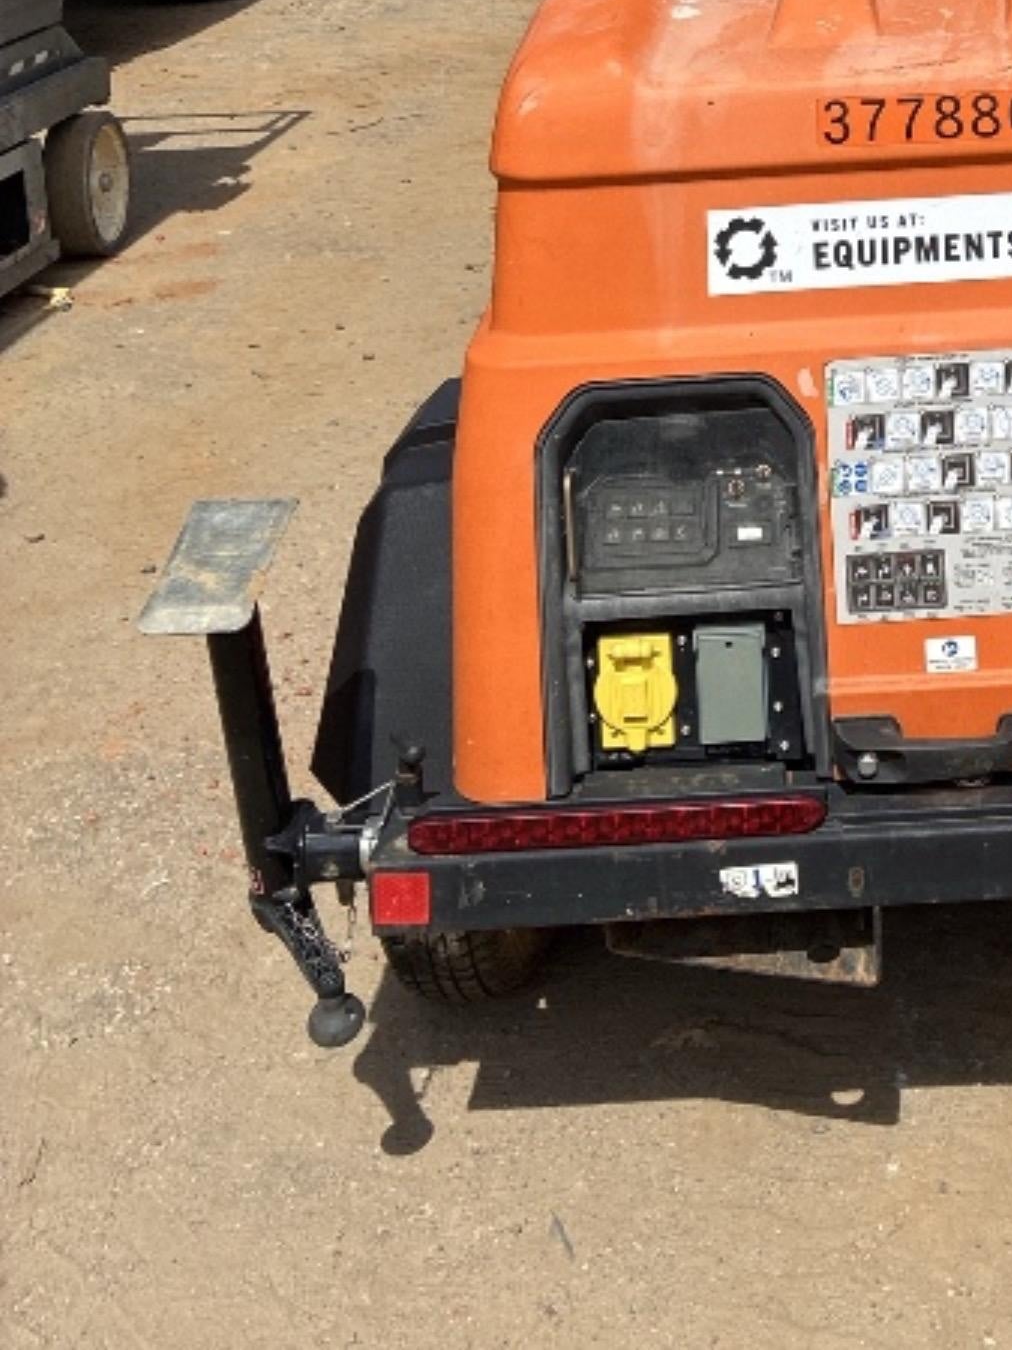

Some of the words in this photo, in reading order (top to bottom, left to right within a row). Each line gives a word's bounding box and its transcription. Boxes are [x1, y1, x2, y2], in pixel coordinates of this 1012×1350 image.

[811, 217, 857, 233] VISIT
[867, 215, 889, 229] US
[897, 212, 926, 228] AT:
[768, 269, 793, 283] TM
